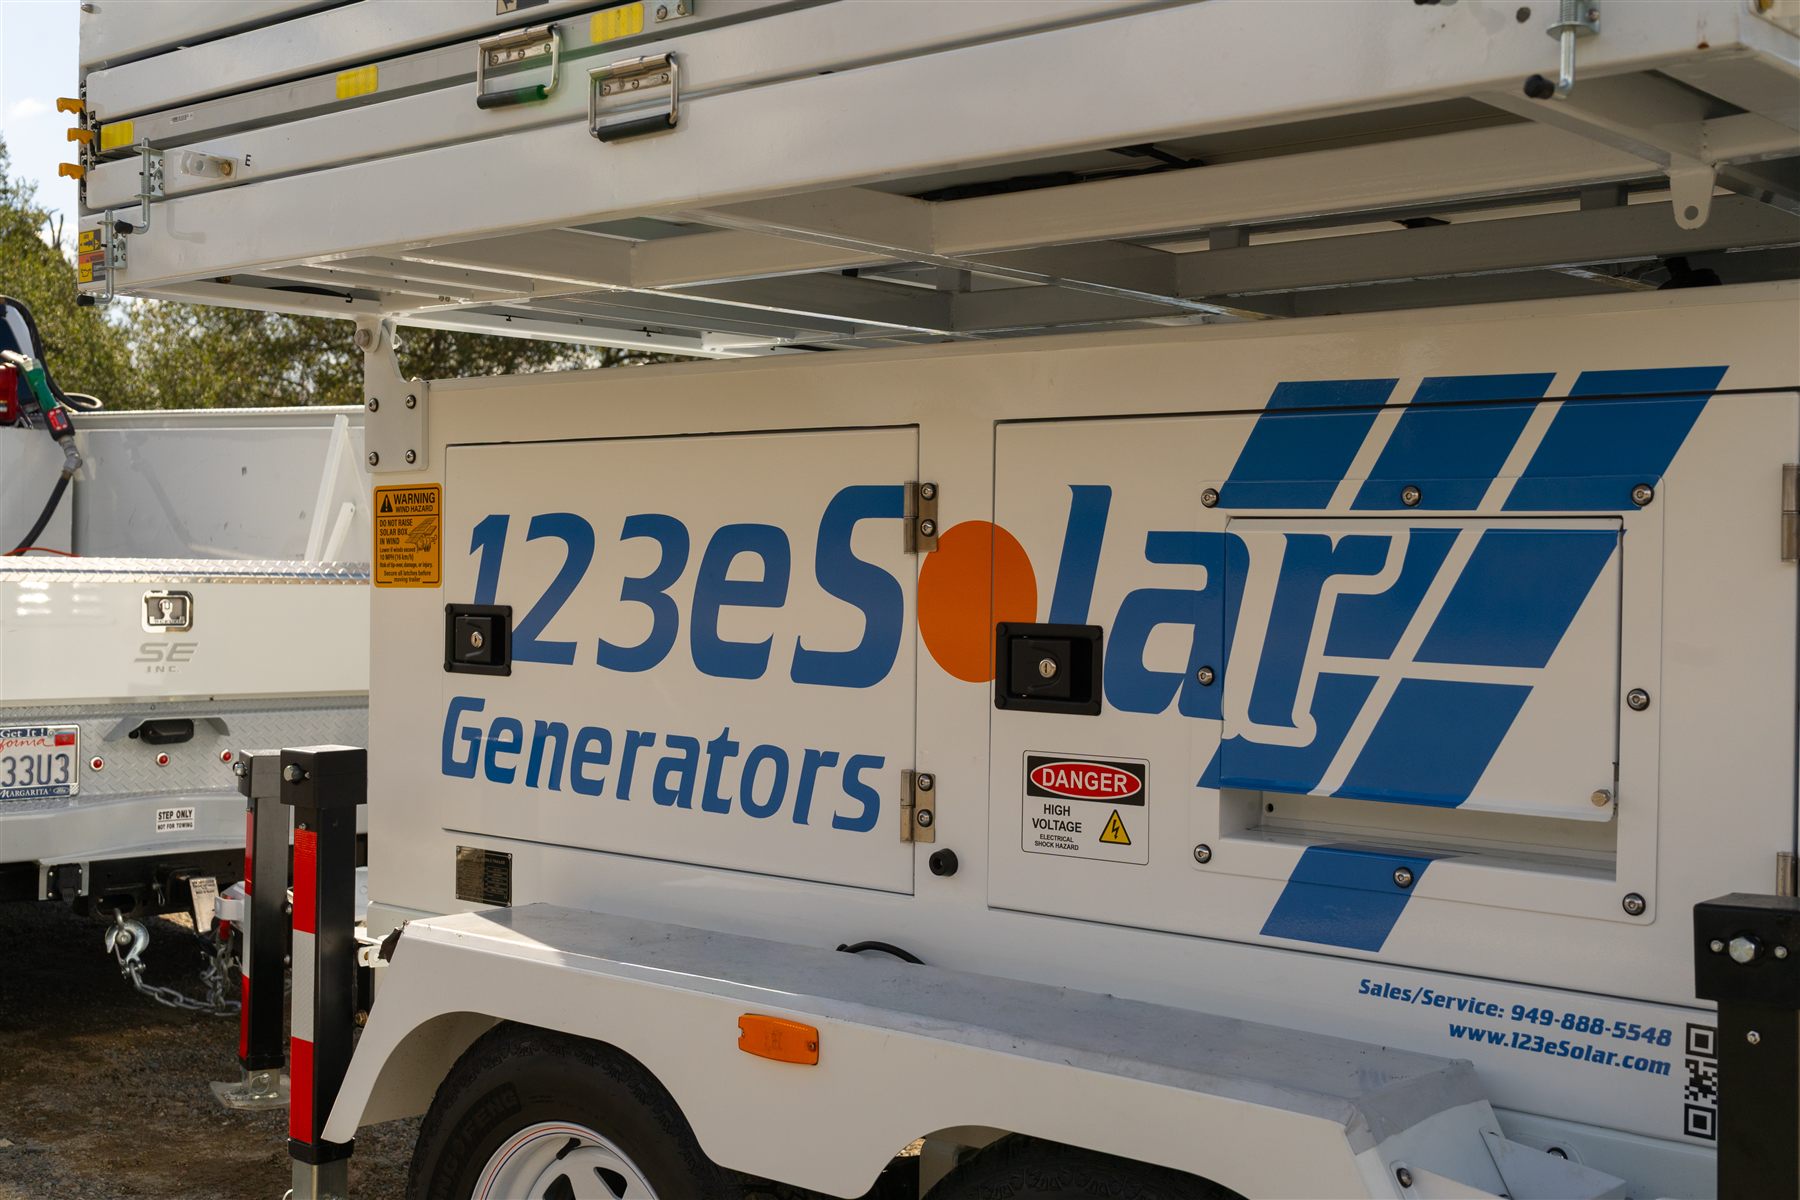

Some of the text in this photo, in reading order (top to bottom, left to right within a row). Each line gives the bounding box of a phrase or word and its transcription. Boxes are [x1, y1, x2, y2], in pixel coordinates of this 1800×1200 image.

[245, 153, 252, 167] E
[393, 492, 436, 505] WARNING
[396, 504, 434, 513] WIND HAZARD
[380, 518, 413, 527] DO NOT RAISE
[380, 528, 408, 536] SOLAR BOX
[134, 642, 199, 663] SE
[0, 730, 22, 738] Get
[26, 728, 36, 737] It
[1, 754, 70, 787] 33U3
[442, 696, 886, 833] Generators
[1042, 768, 1128, 794] DANGER
[1, 788, 48, 798] MARGARITA
[158, 809, 192, 820] STEP ONLY
[1043, 804, 1071, 816] HIGH
[1032, 818, 1082, 833] VOLTAGE
[1040, 834, 1074, 844] ELECTRICAL
[1034, 840, 1080, 851] SHOCK HAZARD
[1358, 978, 1673, 1048] Sales/Service: 949-888-5548
[1449, 1023, 1672, 1077] www.123eSolar.com
